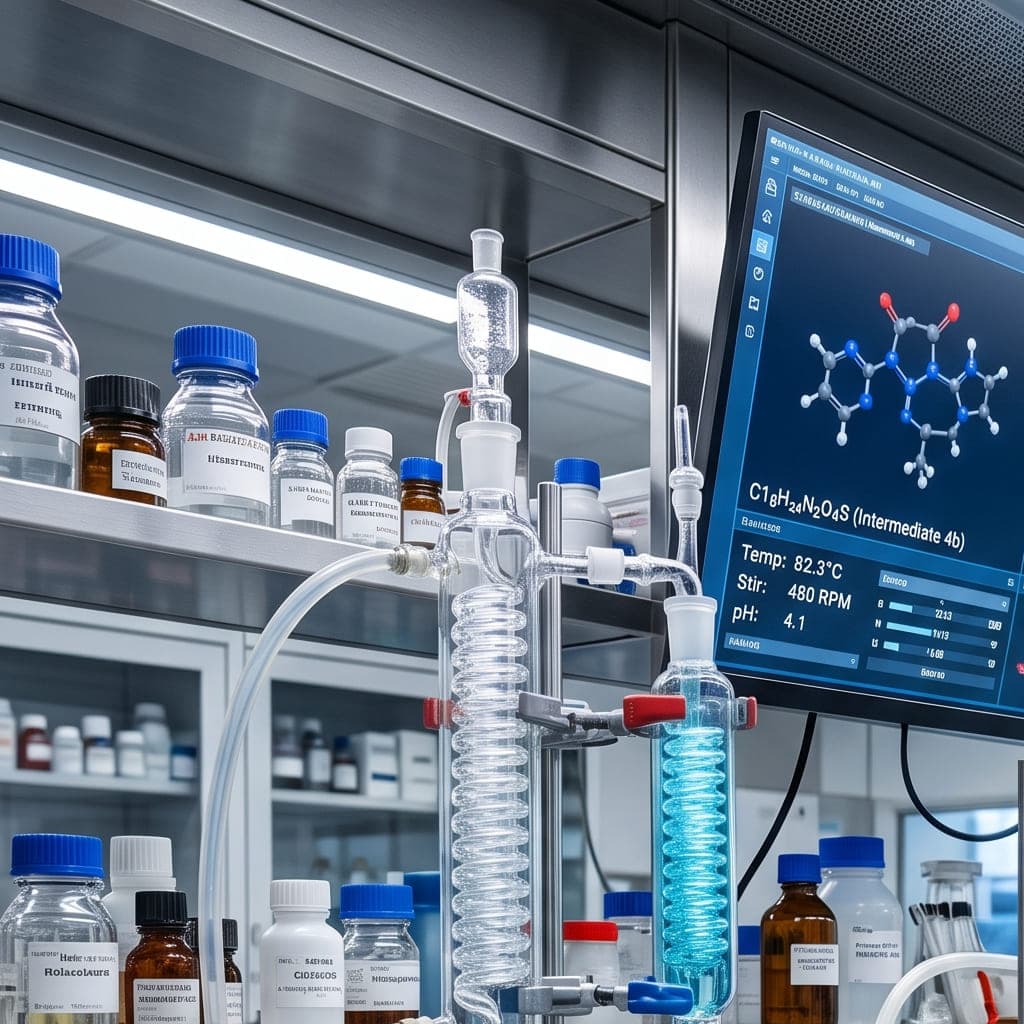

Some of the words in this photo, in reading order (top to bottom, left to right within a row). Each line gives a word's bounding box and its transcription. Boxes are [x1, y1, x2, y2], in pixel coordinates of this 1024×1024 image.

[853, 506, 941, 544] (Intermediate
[943, 530, 965, 553] 4b)
[742, 543, 787, 571] Temp:
[794, 555, 843, 580] 82.3°C
[737, 573, 767, 594] Stir:
[787, 583, 815, 603] 480
[818, 588, 852, 613] RPM
[731, 604, 759, 624] pH:
[783, 612, 805, 631] 4.1
